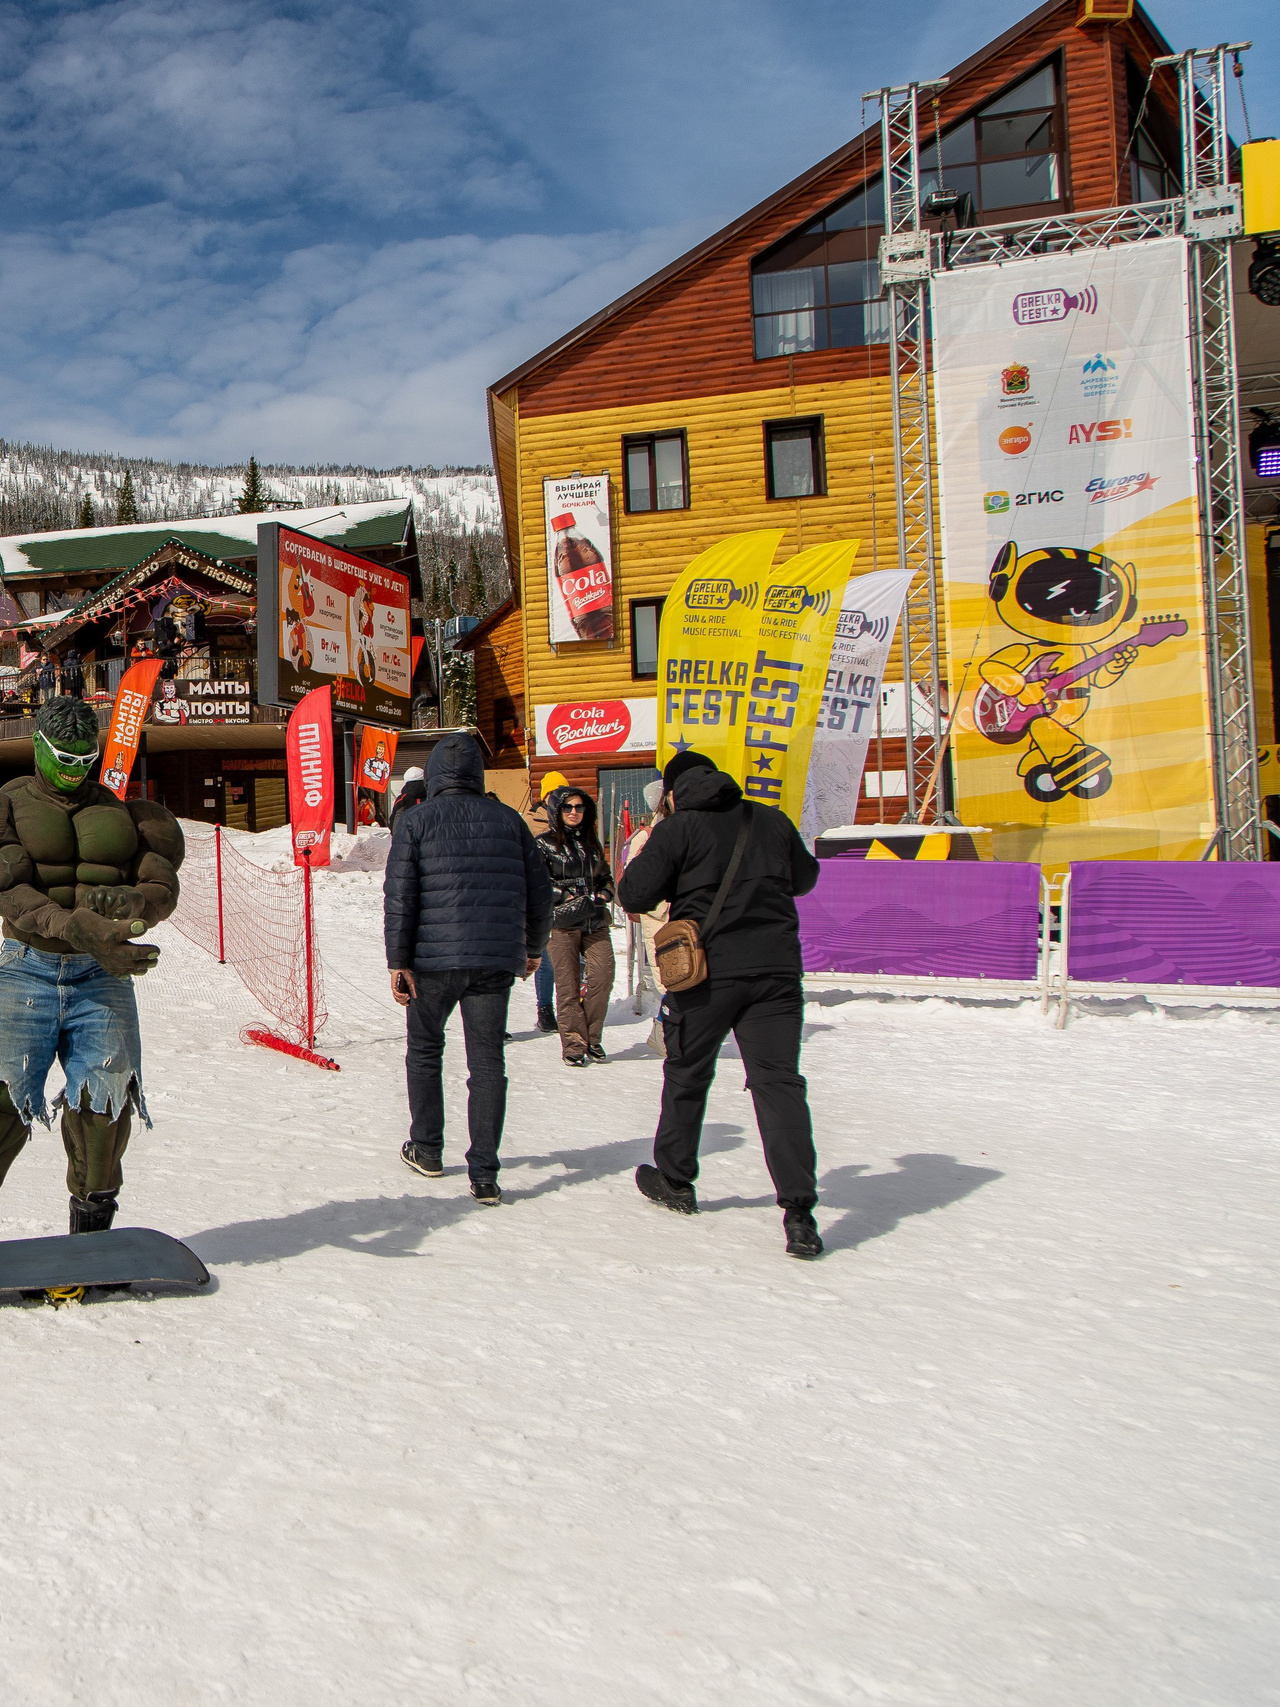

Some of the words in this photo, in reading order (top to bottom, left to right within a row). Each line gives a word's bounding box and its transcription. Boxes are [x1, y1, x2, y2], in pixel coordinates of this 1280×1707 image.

[1021, 293, 1061, 309] GRELKA
[1021, 306, 1049, 321] FEST
[1068, 418, 1133, 445] AYS!
[555, 480, 601, 492] ВЫБИРАЙ
[1015, 490, 1065, 506] 2ГИС
[136, 561, 160, 583] ЭТО
[177, 553, 200, 571] ПО
[202, 565, 253, 594] ЛЮБВИ
[284, 540, 327, 566] СОГРЕВАЕМ
[327, 556, 332, 567] В
[333, 559, 368, 580] ШЕРЕГЕШЕ
[368, 572, 383, 586] УЖЕ
[383, 578, 390, 589] 10
[391, 581, 405, 594] ЛЕТ!
[562, 569, 607, 596] Cola
[693, 583, 729, 593] GRELKA
[691, 594, 715, 605] FEST
[770, 589, 803, 599] GRELKA
[767, 599, 789, 608] FEST
[684, 614, 699, 623] SUN
[700, 615, 707, 623] &
[708, 615, 726, 624] RIDE
[761, 616, 772, 625] UN
[773, 618, 779, 626] &
[780, 618, 797, 628] RIDE
[682, 627, 706, 637] MUSIC
[708, 627, 742, 638] FESTIVAL
[779, 630, 812, 642] FESTIVAL
[839, 642, 857, 653] RIDE
[838, 655, 869, 667] FESTIVAL
[666, 658, 748, 686] GRELKA
[189, 681, 250, 695] МАНТЫ
[335, 680, 366, 703] GRELKA
[665, 687, 745, 726] FEST
[744, 649, 804, 752] FEST
[190, 701, 250, 716] ПОНТЫ
[570, 707, 605, 719] Cola
[113, 689, 134, 744] МАНТЫ
[123, 692, 144, 747] ПОНТЫ
[553, 719, 625, 746] Bochkari
[298, 723, 323, 807] ФИНИШ
